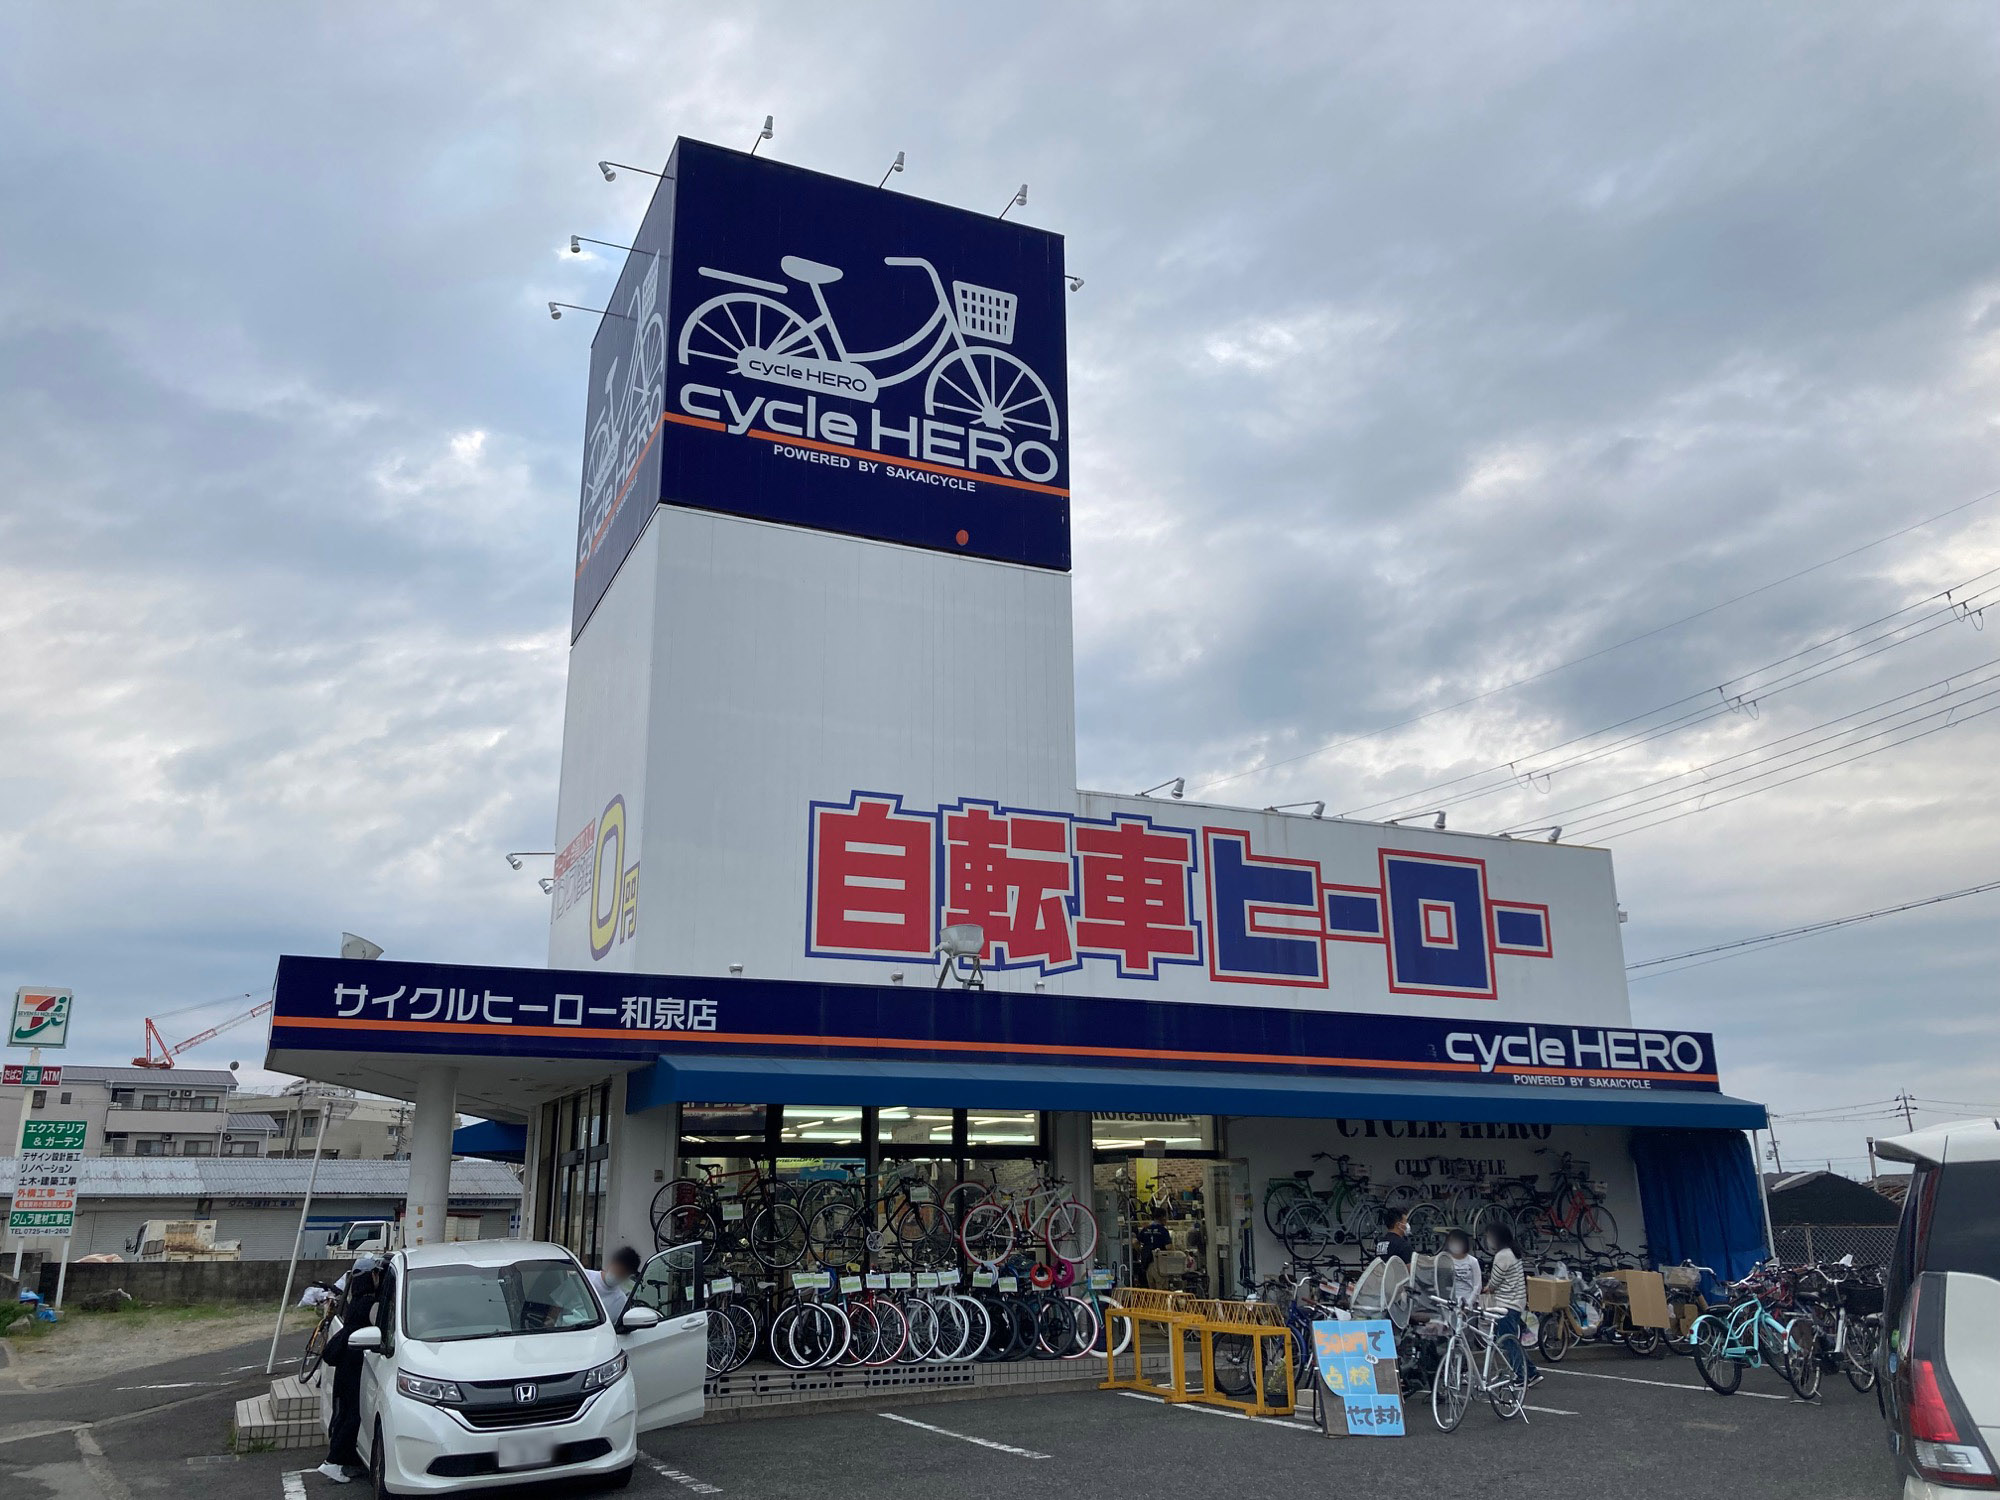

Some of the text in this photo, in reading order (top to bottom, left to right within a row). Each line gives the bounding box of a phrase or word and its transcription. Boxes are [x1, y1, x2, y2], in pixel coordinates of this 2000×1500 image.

[748, 358, 868, 393] cycle HERO
[679, 382, 1059, 483] cycle HERO
[613, 384, 663, 502] HERO
[773, 444, 977, 493] POWERED BY SAKAICYCLE
[804, 790, 1553, 1000] 自転車ヒーロー
[334, 983, 718, 1031] サイクルヒーロー和泉店
[1445, 1027, 1703, 1073] cycle HERO
[4, 1069, 60, 1081] たばこ 酒 ATM
[1513, 1074, 1651, 1090] POWERED BY SAKAICYCLE
[26, 1123, 85, 1134] エクステリア
[33, 1137, 83, 1147] & ガーデン
[23, 1152, 81, 1162] デザイン設計施工
[21, 1164, 73, 1173] リノベーション
[17, 1188, 76, 1198] 外構工事一式
[12, 1213, 71, 1225] タムラ建材工事店
[1325, 1365, 1372, 1390] 点検
